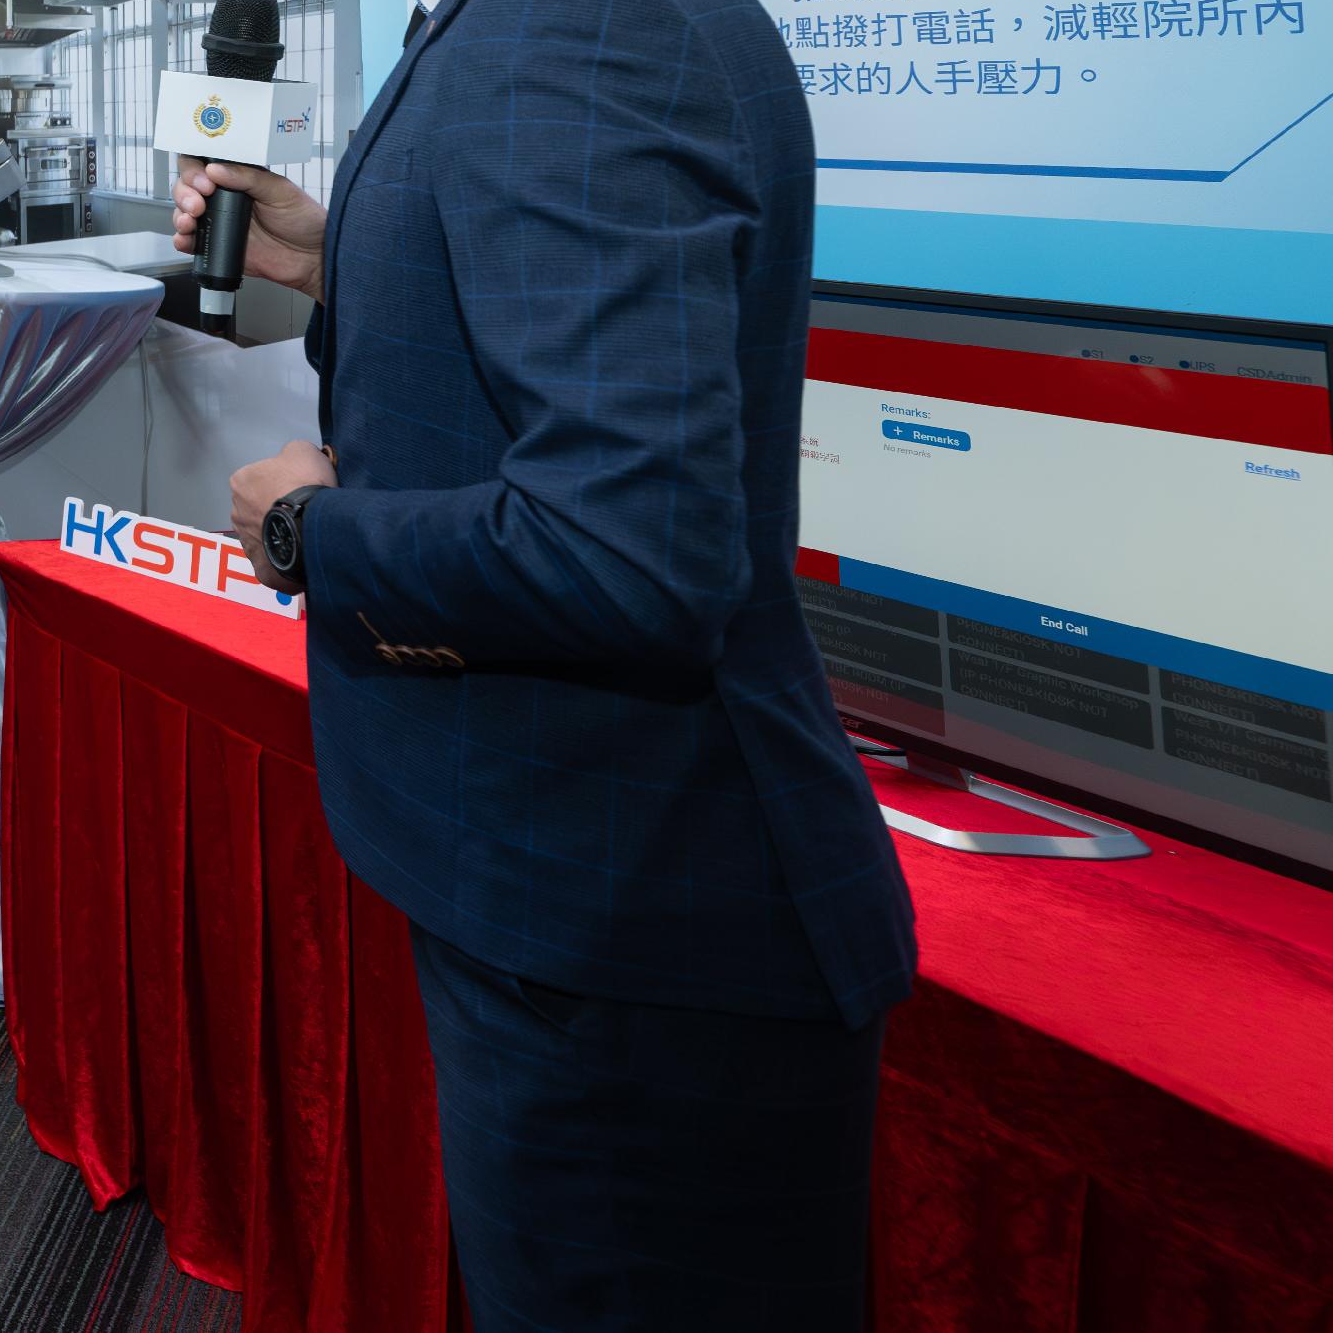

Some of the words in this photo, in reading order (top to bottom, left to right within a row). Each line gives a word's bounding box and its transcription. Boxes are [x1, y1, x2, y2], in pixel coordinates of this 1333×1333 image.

[276, 118, 304, 134] HKSTP
[1091, 349, 1104, 359] S1
[1139, 354, 1155, 365] S2
[1237, 366, 1313, 384] CSDAdmin
[881, 403, 931, 419] Remarks:
[913, 430, 960, 447] Remarks
[883, 443, 896, 452] No
[897, 445, 931, 458] remarks
[1244, 460, 1301, 481] Refresh
[65, 502, 262, 593] HKSTP
[1040, 615, 1063, 631] End
[1066, 622, 1089, 637] Call
[1070, 681, 1140, 711] Workshop
[1079, 701, 1108, 719] NOT
